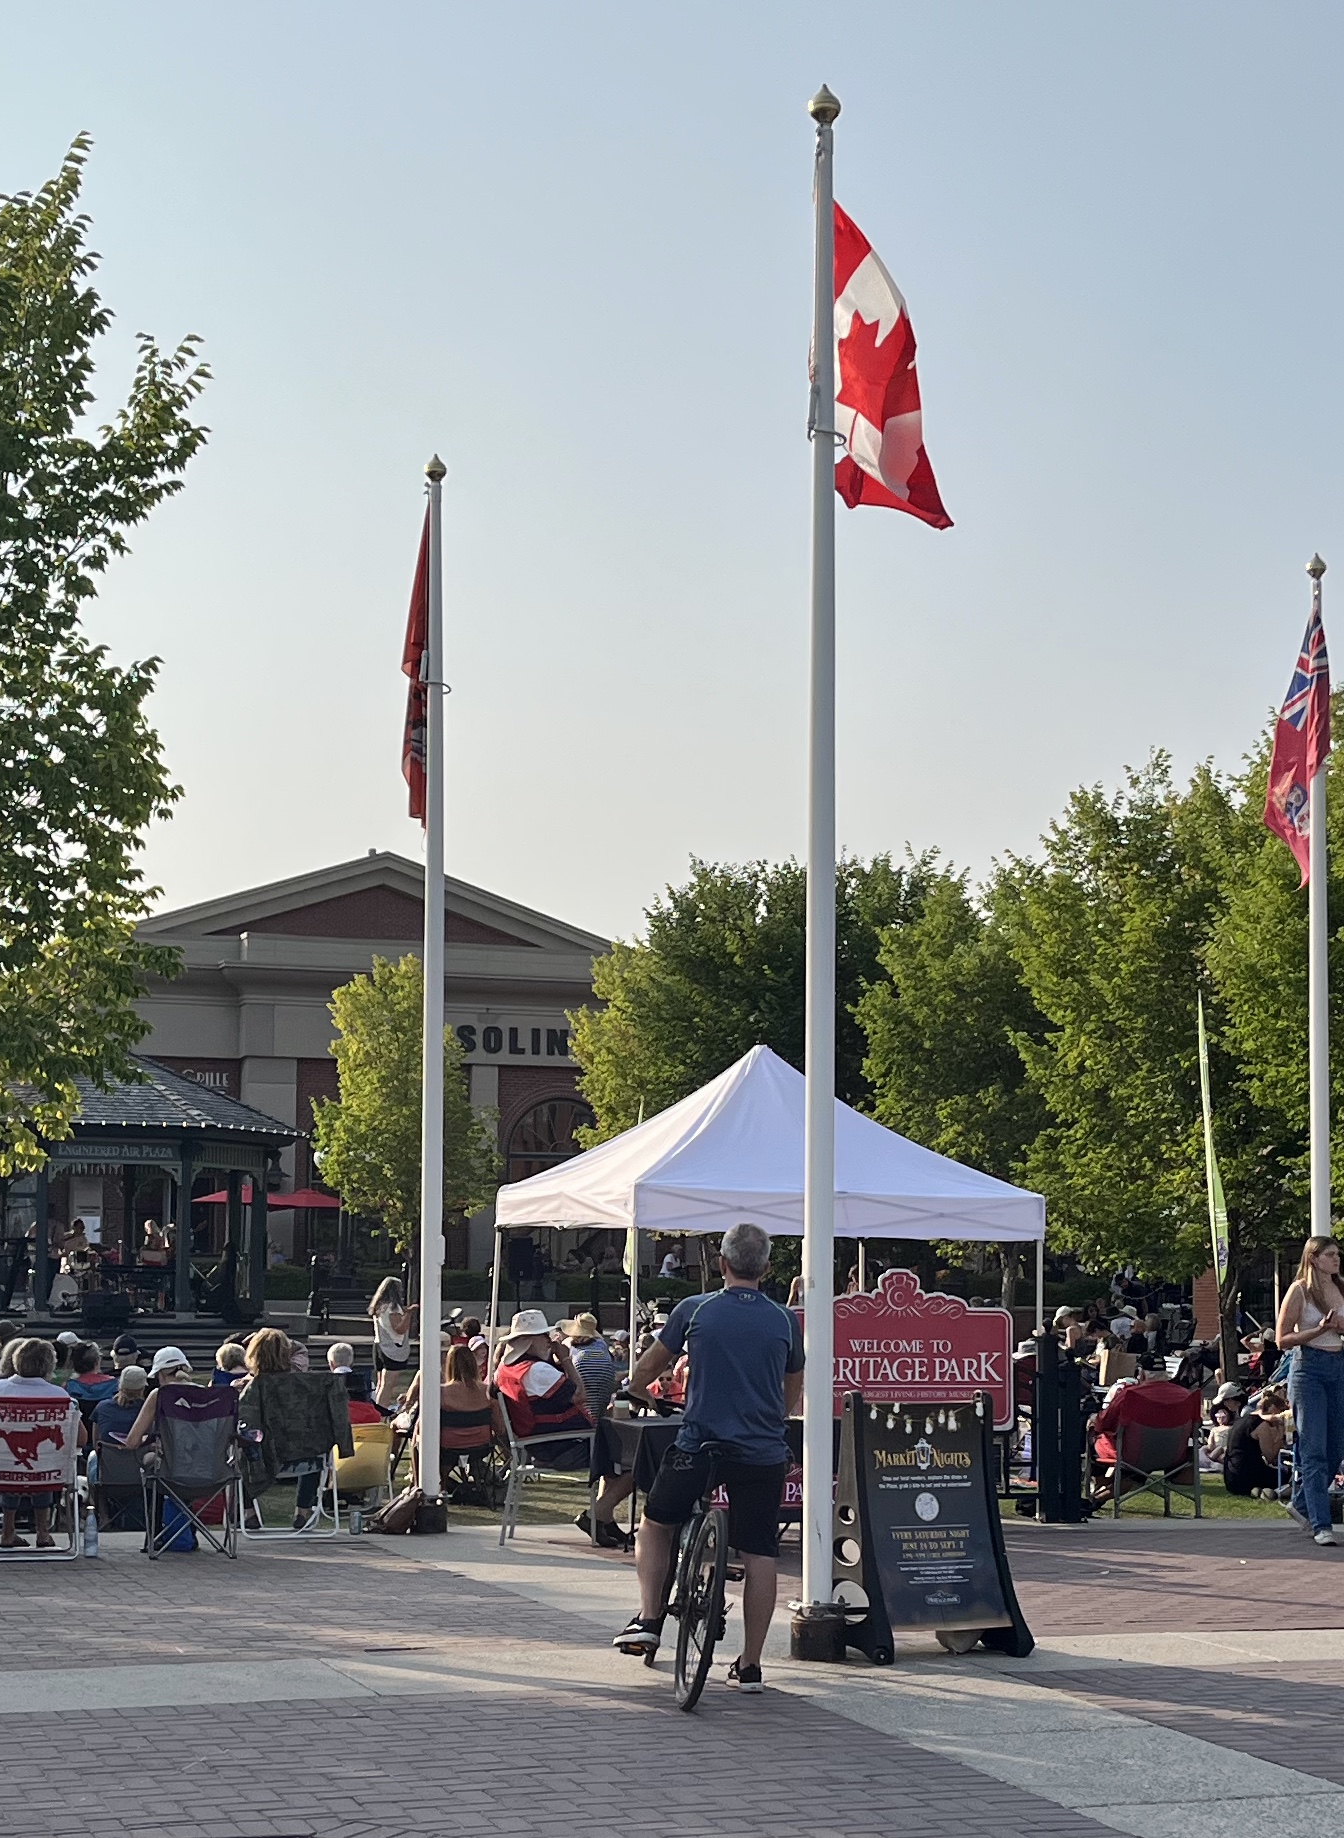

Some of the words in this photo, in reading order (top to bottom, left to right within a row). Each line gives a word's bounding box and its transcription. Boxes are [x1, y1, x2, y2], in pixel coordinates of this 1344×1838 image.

[58, 1143, 120, 1157] ENGINEERED
[121, 1144, 141, 1158] AIR
[142, 1145, 174, 1158] PLAZA
[849, 1339, 924, 1353] WELCOME
[930, 1339, 952, 1354] TO
[833, 1356, 930, 1388] ERITAGE
[933, 1351, 1003, 1382] PARK
[863, 1390, 889, 1399] ARGEST
[890, 1390, 916, 1399] LIVING
[917, 1390, 947, 1399] HISTORY
[949, 1390, 973, 1399] MUSEU
[874, 1449, 916, 1469] MARKET
[932, 1448, 971, 1468] NIGHTS
[949, 1529, 970, 1538] NIGHT
